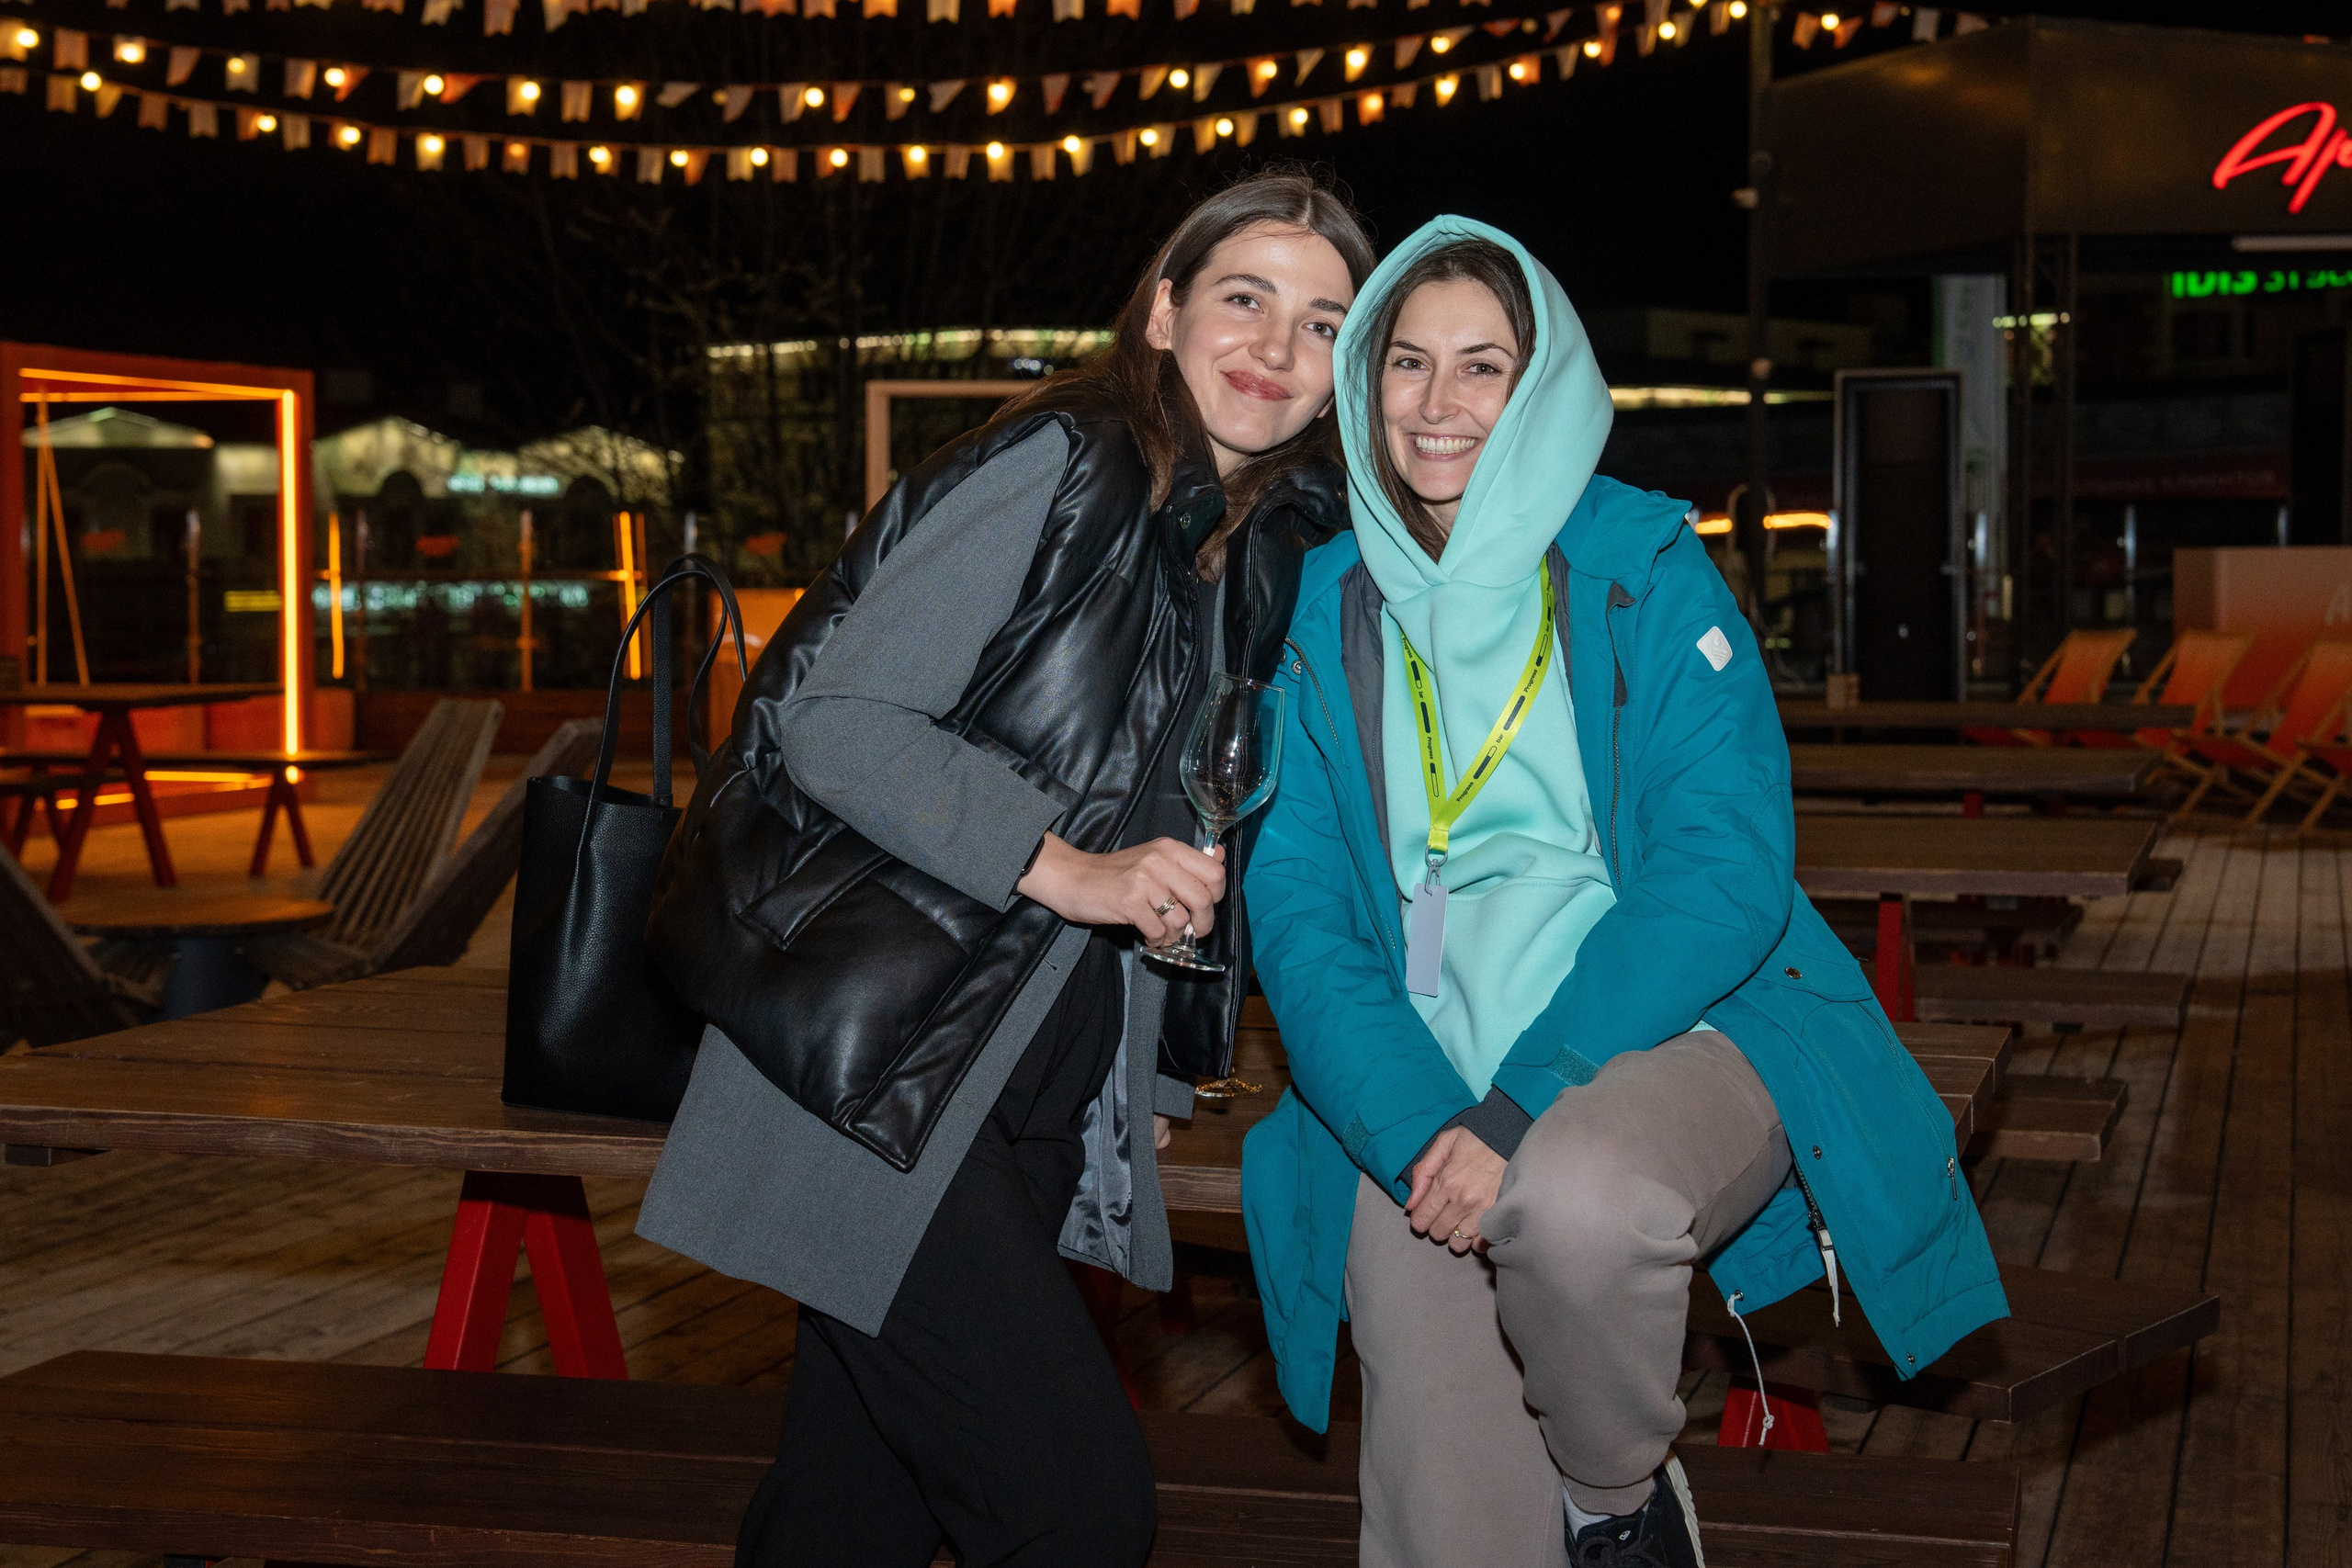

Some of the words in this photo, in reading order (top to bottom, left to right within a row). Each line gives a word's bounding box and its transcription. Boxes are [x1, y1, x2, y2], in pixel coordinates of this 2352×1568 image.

[1402, 637, 1413, 659] Progress
[1455, 781, 1475, 803] Progress
[1495, 734, 1504, 744] bar
[1523, 669, 1538, 693] Progress
